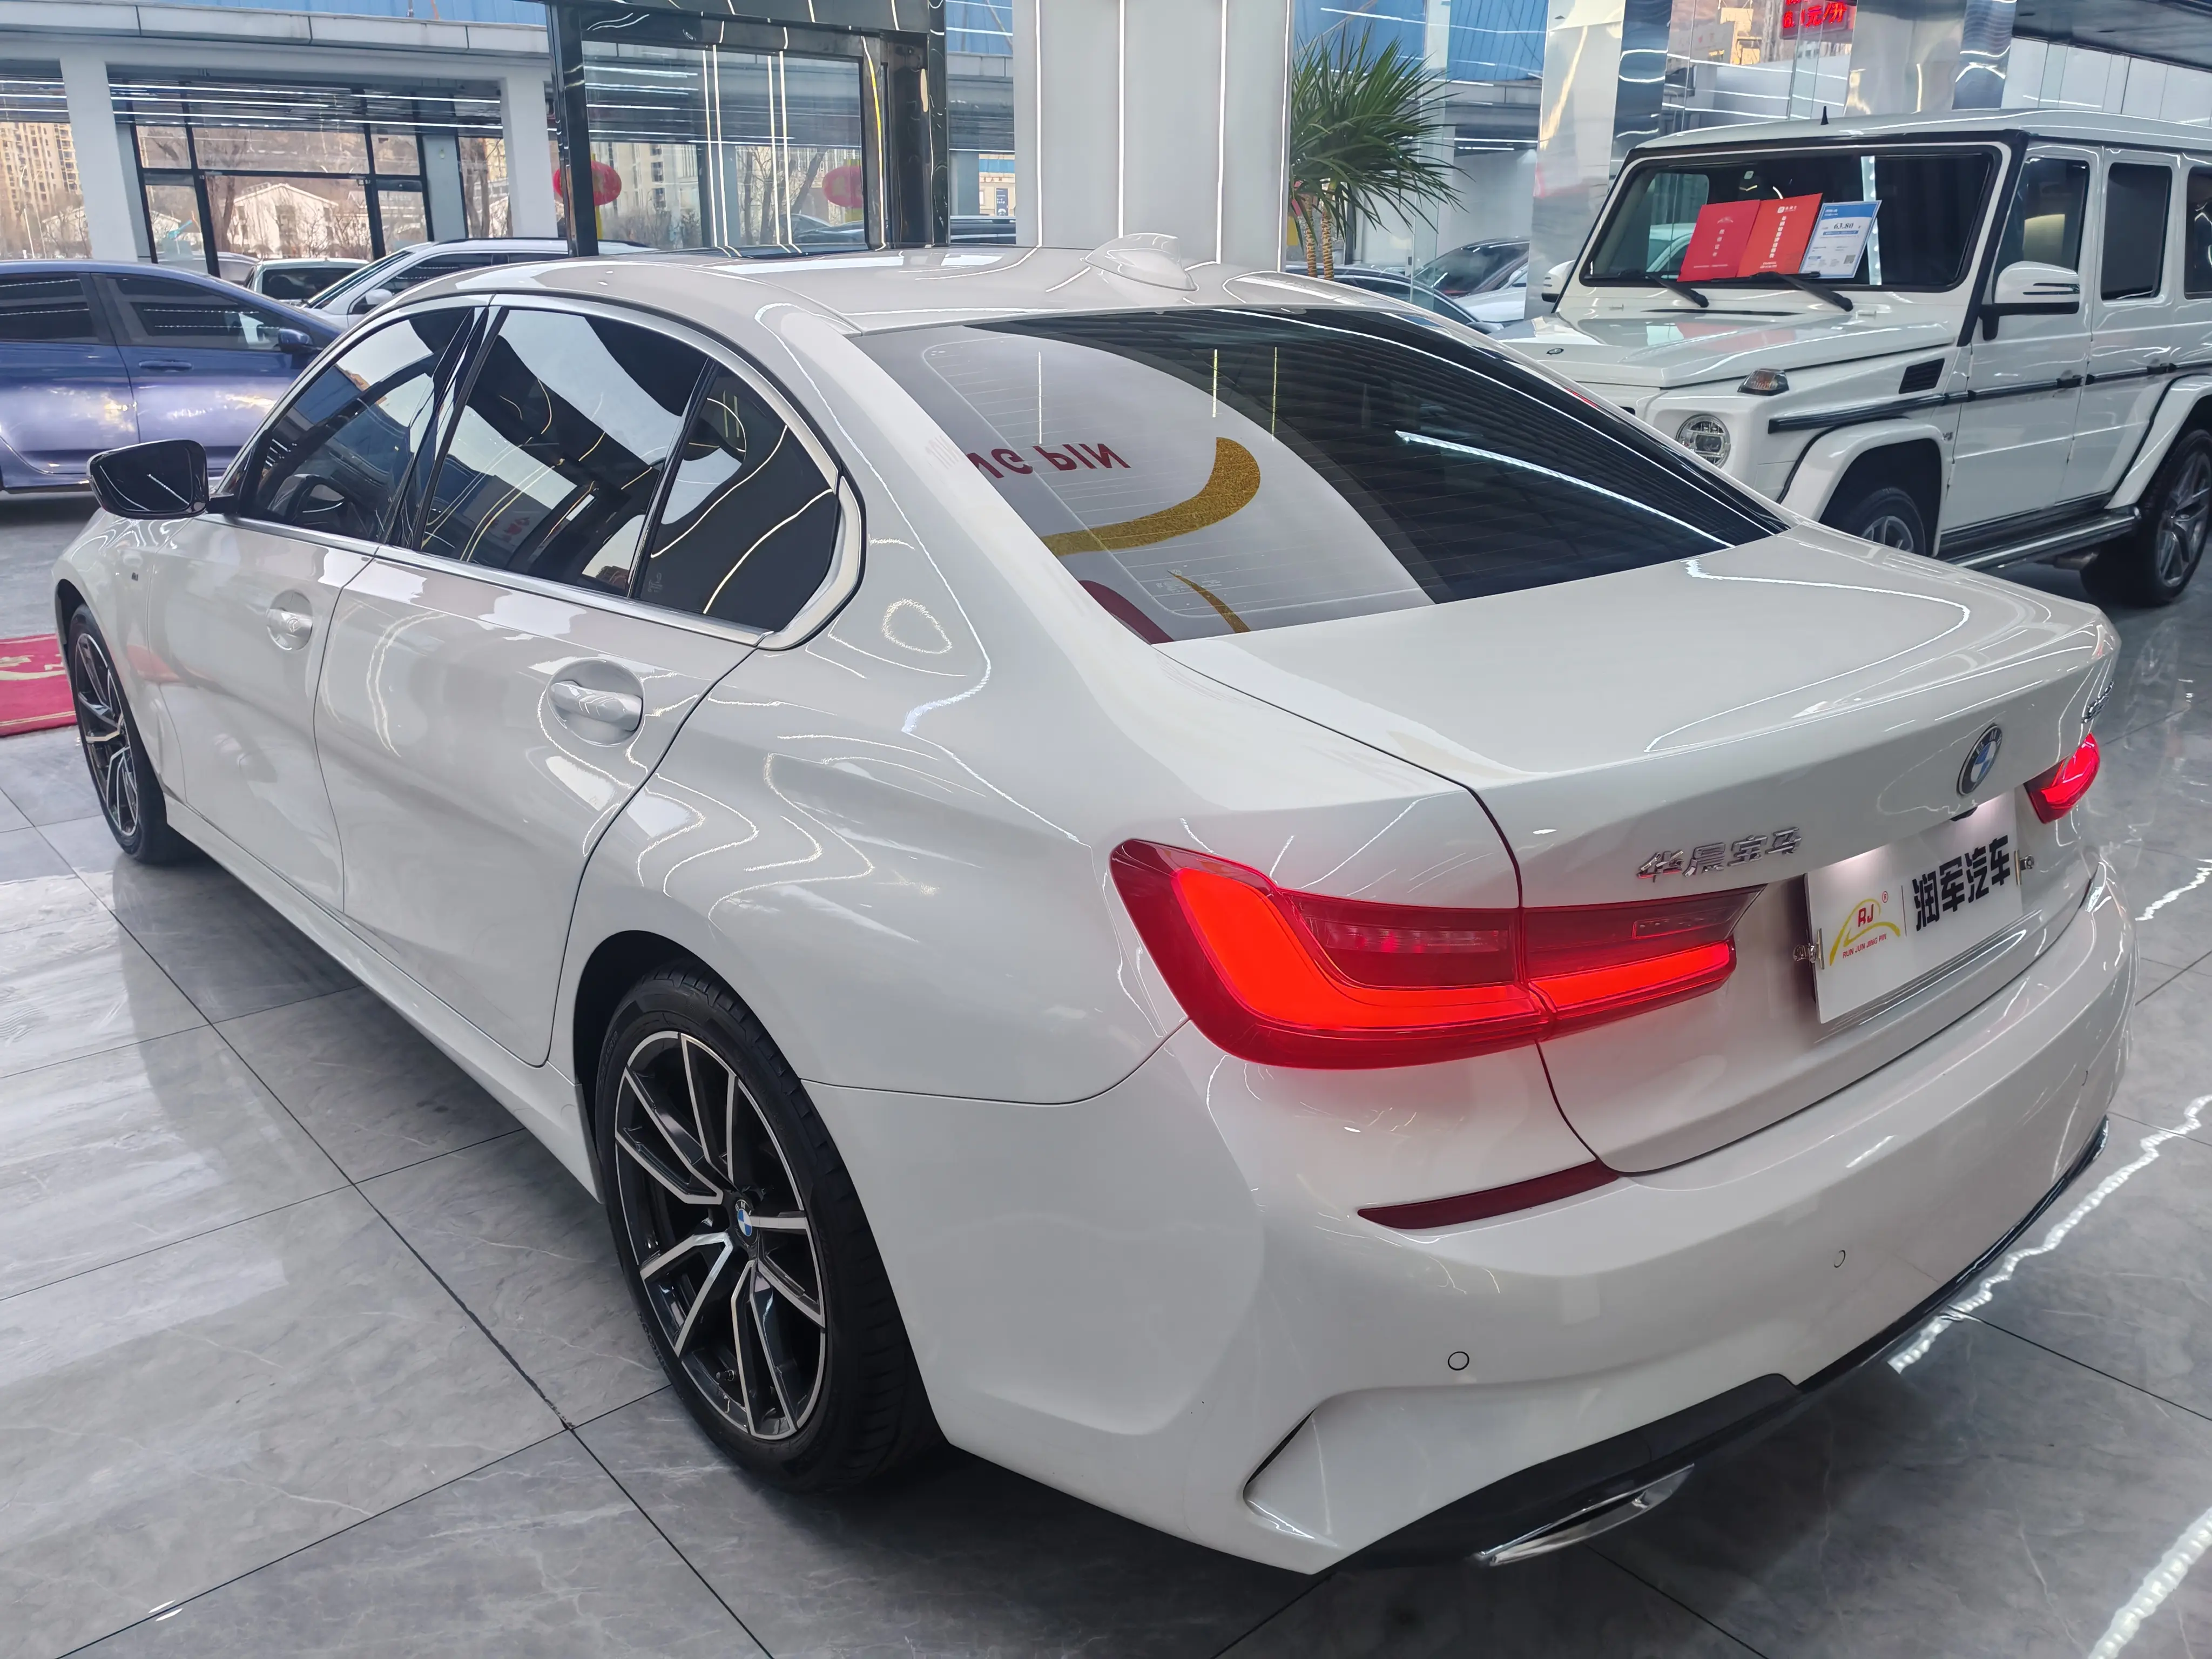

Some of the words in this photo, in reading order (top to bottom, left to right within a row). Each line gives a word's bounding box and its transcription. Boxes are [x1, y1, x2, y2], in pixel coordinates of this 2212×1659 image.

[1636, 826, 1802, 882] 华晨宝马
[1912, 835, 2011, 931] 润军汽车
[1843, 948, 1853, 959] RUN
[1855, 942, 1865, 953] JUN
[1866, 937, 1878, 948] JING
[1879, 933, 1887, 942] PIN
